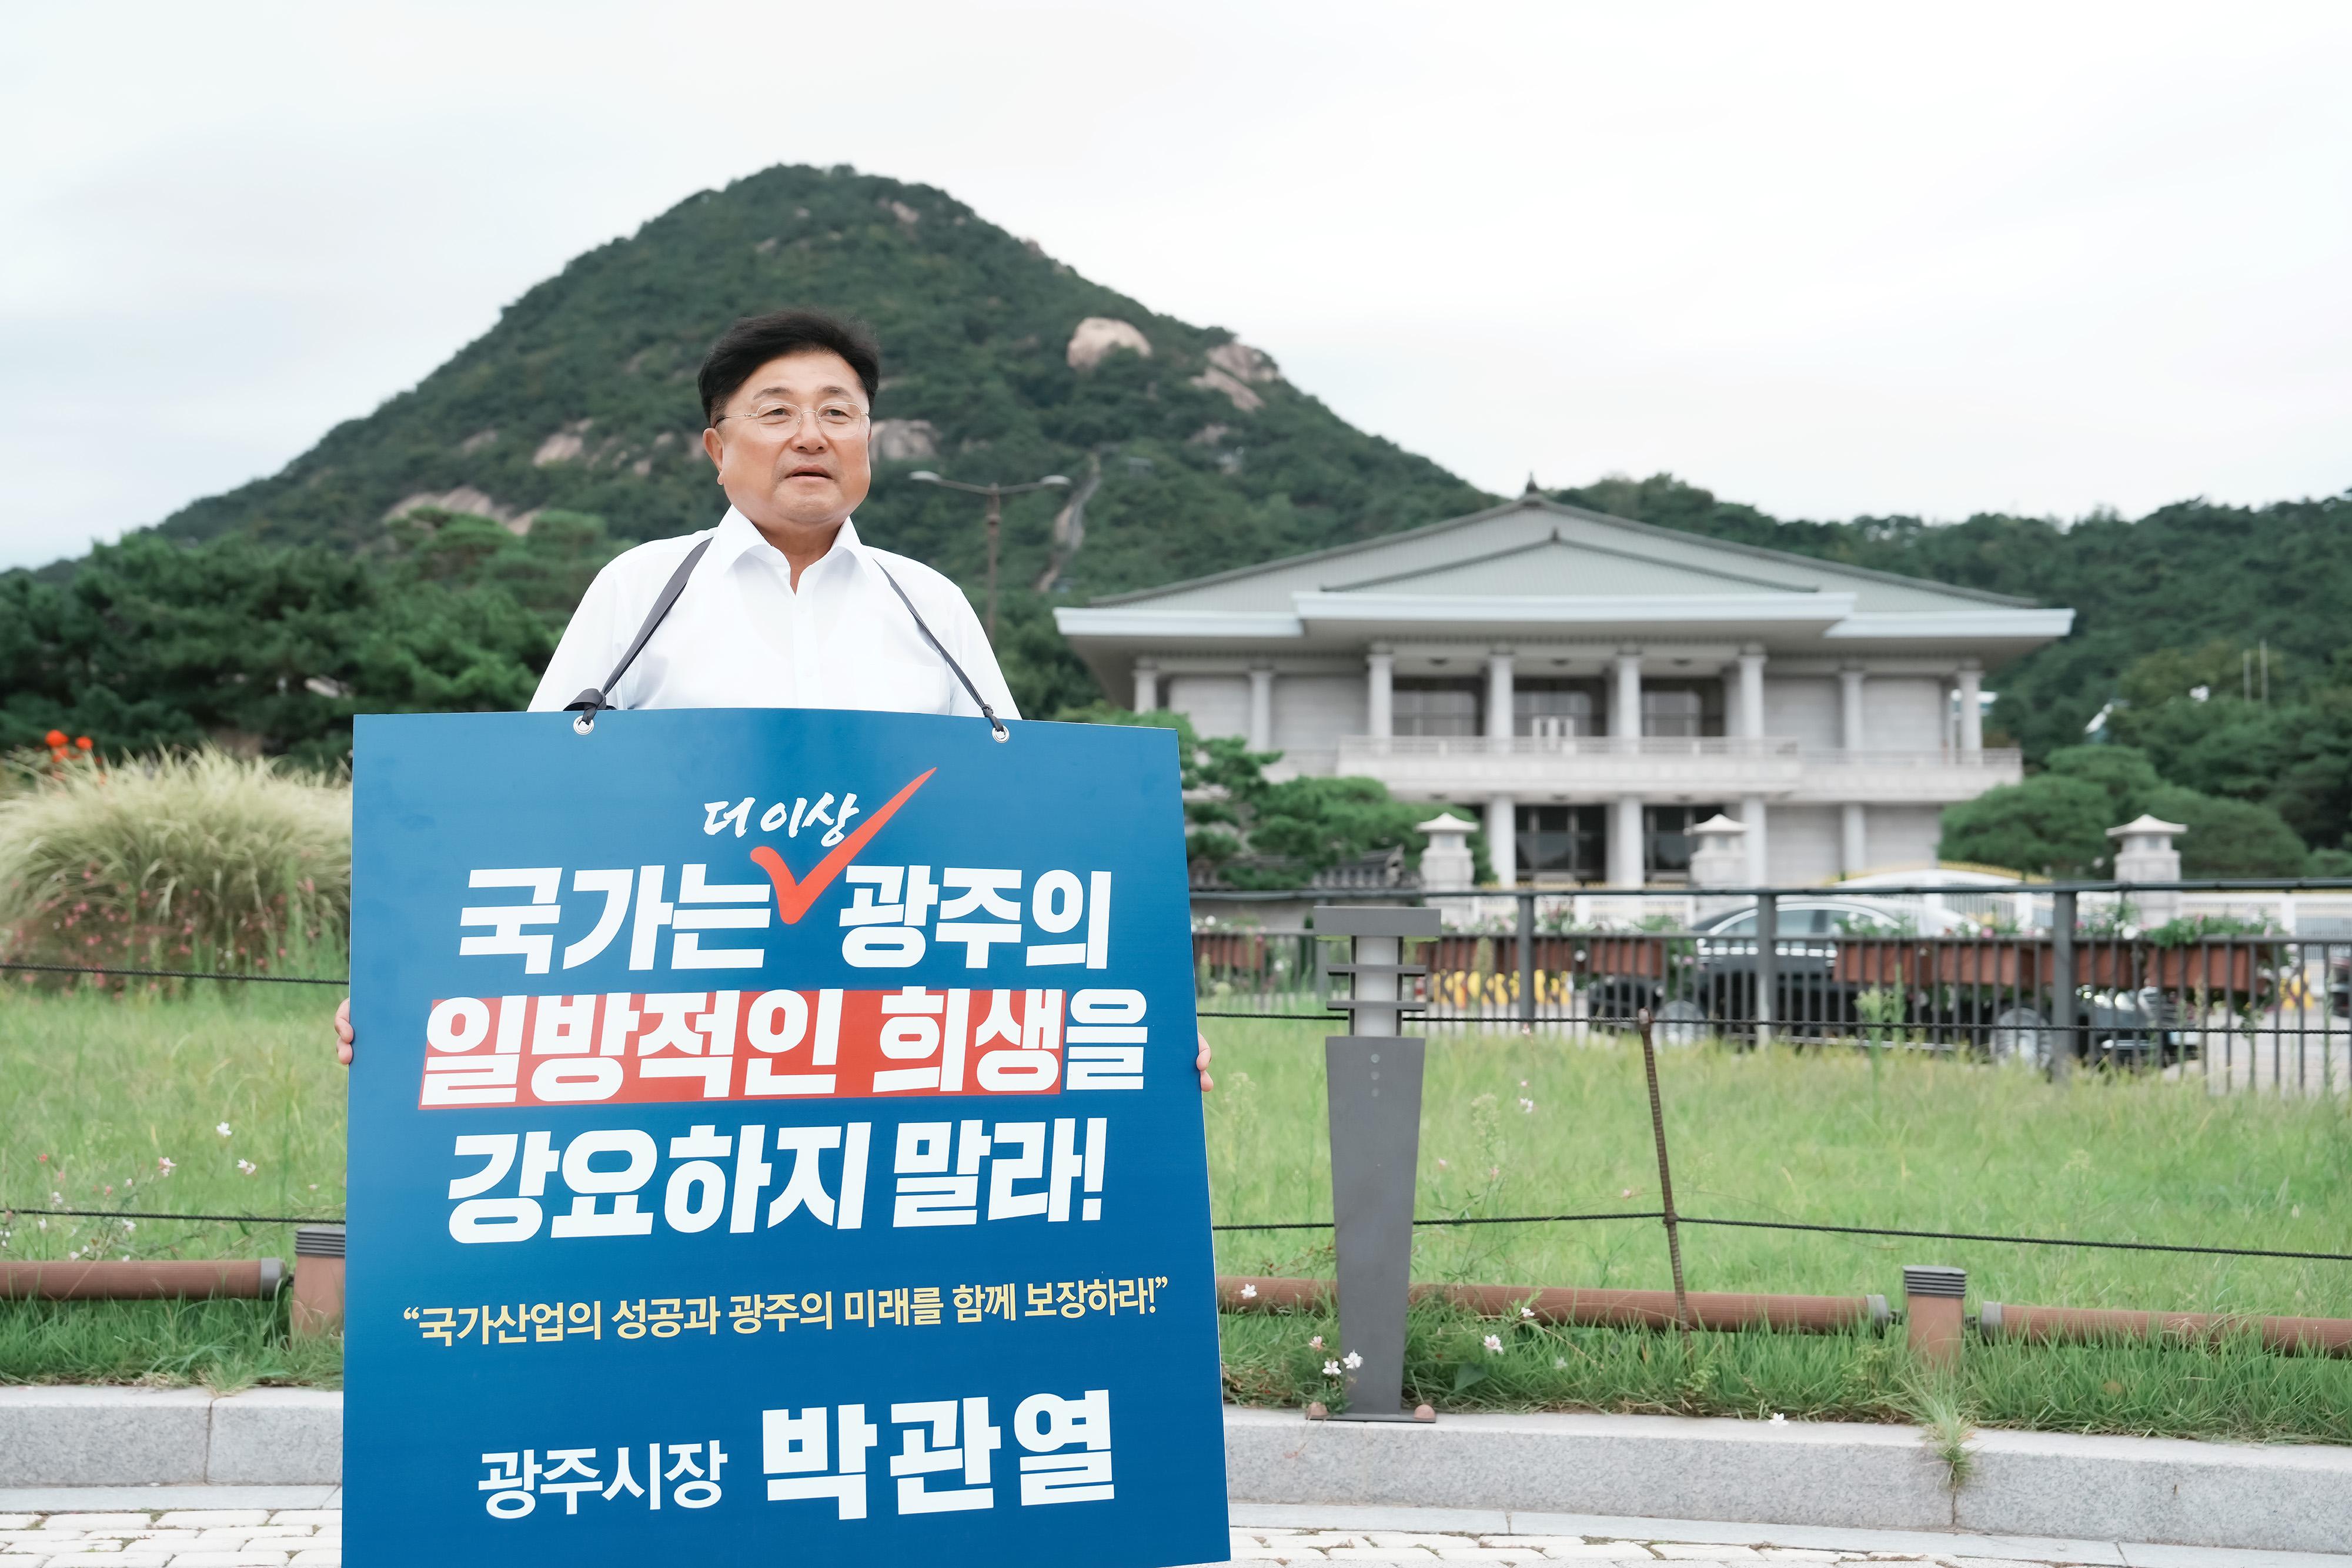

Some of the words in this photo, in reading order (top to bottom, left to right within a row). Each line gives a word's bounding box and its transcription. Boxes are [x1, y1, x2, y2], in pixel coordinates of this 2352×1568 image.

[703, 797, 756, 838] 더
[760, 791, 860, 847] 이상
[459, 863, 771, 975] 국가는
[838, 865, 1112, 969] 광주의
[420, 988, 844, 1106] 일방적인
[872, 986, 1148, 1093] 희생을
[447, 1122, 872, 1244] 강요하지
[893, 1117, 1107, 1228] 말라!
[403, 1300, 601, 1347] “국가산업의
[611, 1296, 721, 1339] 성공과
[729, 1291, 833, 1334] 광주의
[844, 1287, 944, 1328] 미래를
[952, 1283, 1016, 1323] 함께
[1024, 1276, 1168, 1319] 보장하라!”
[478, 1440, 728, 1519] 광주시장
[762, 1389, 1115, 1520] 박관열
